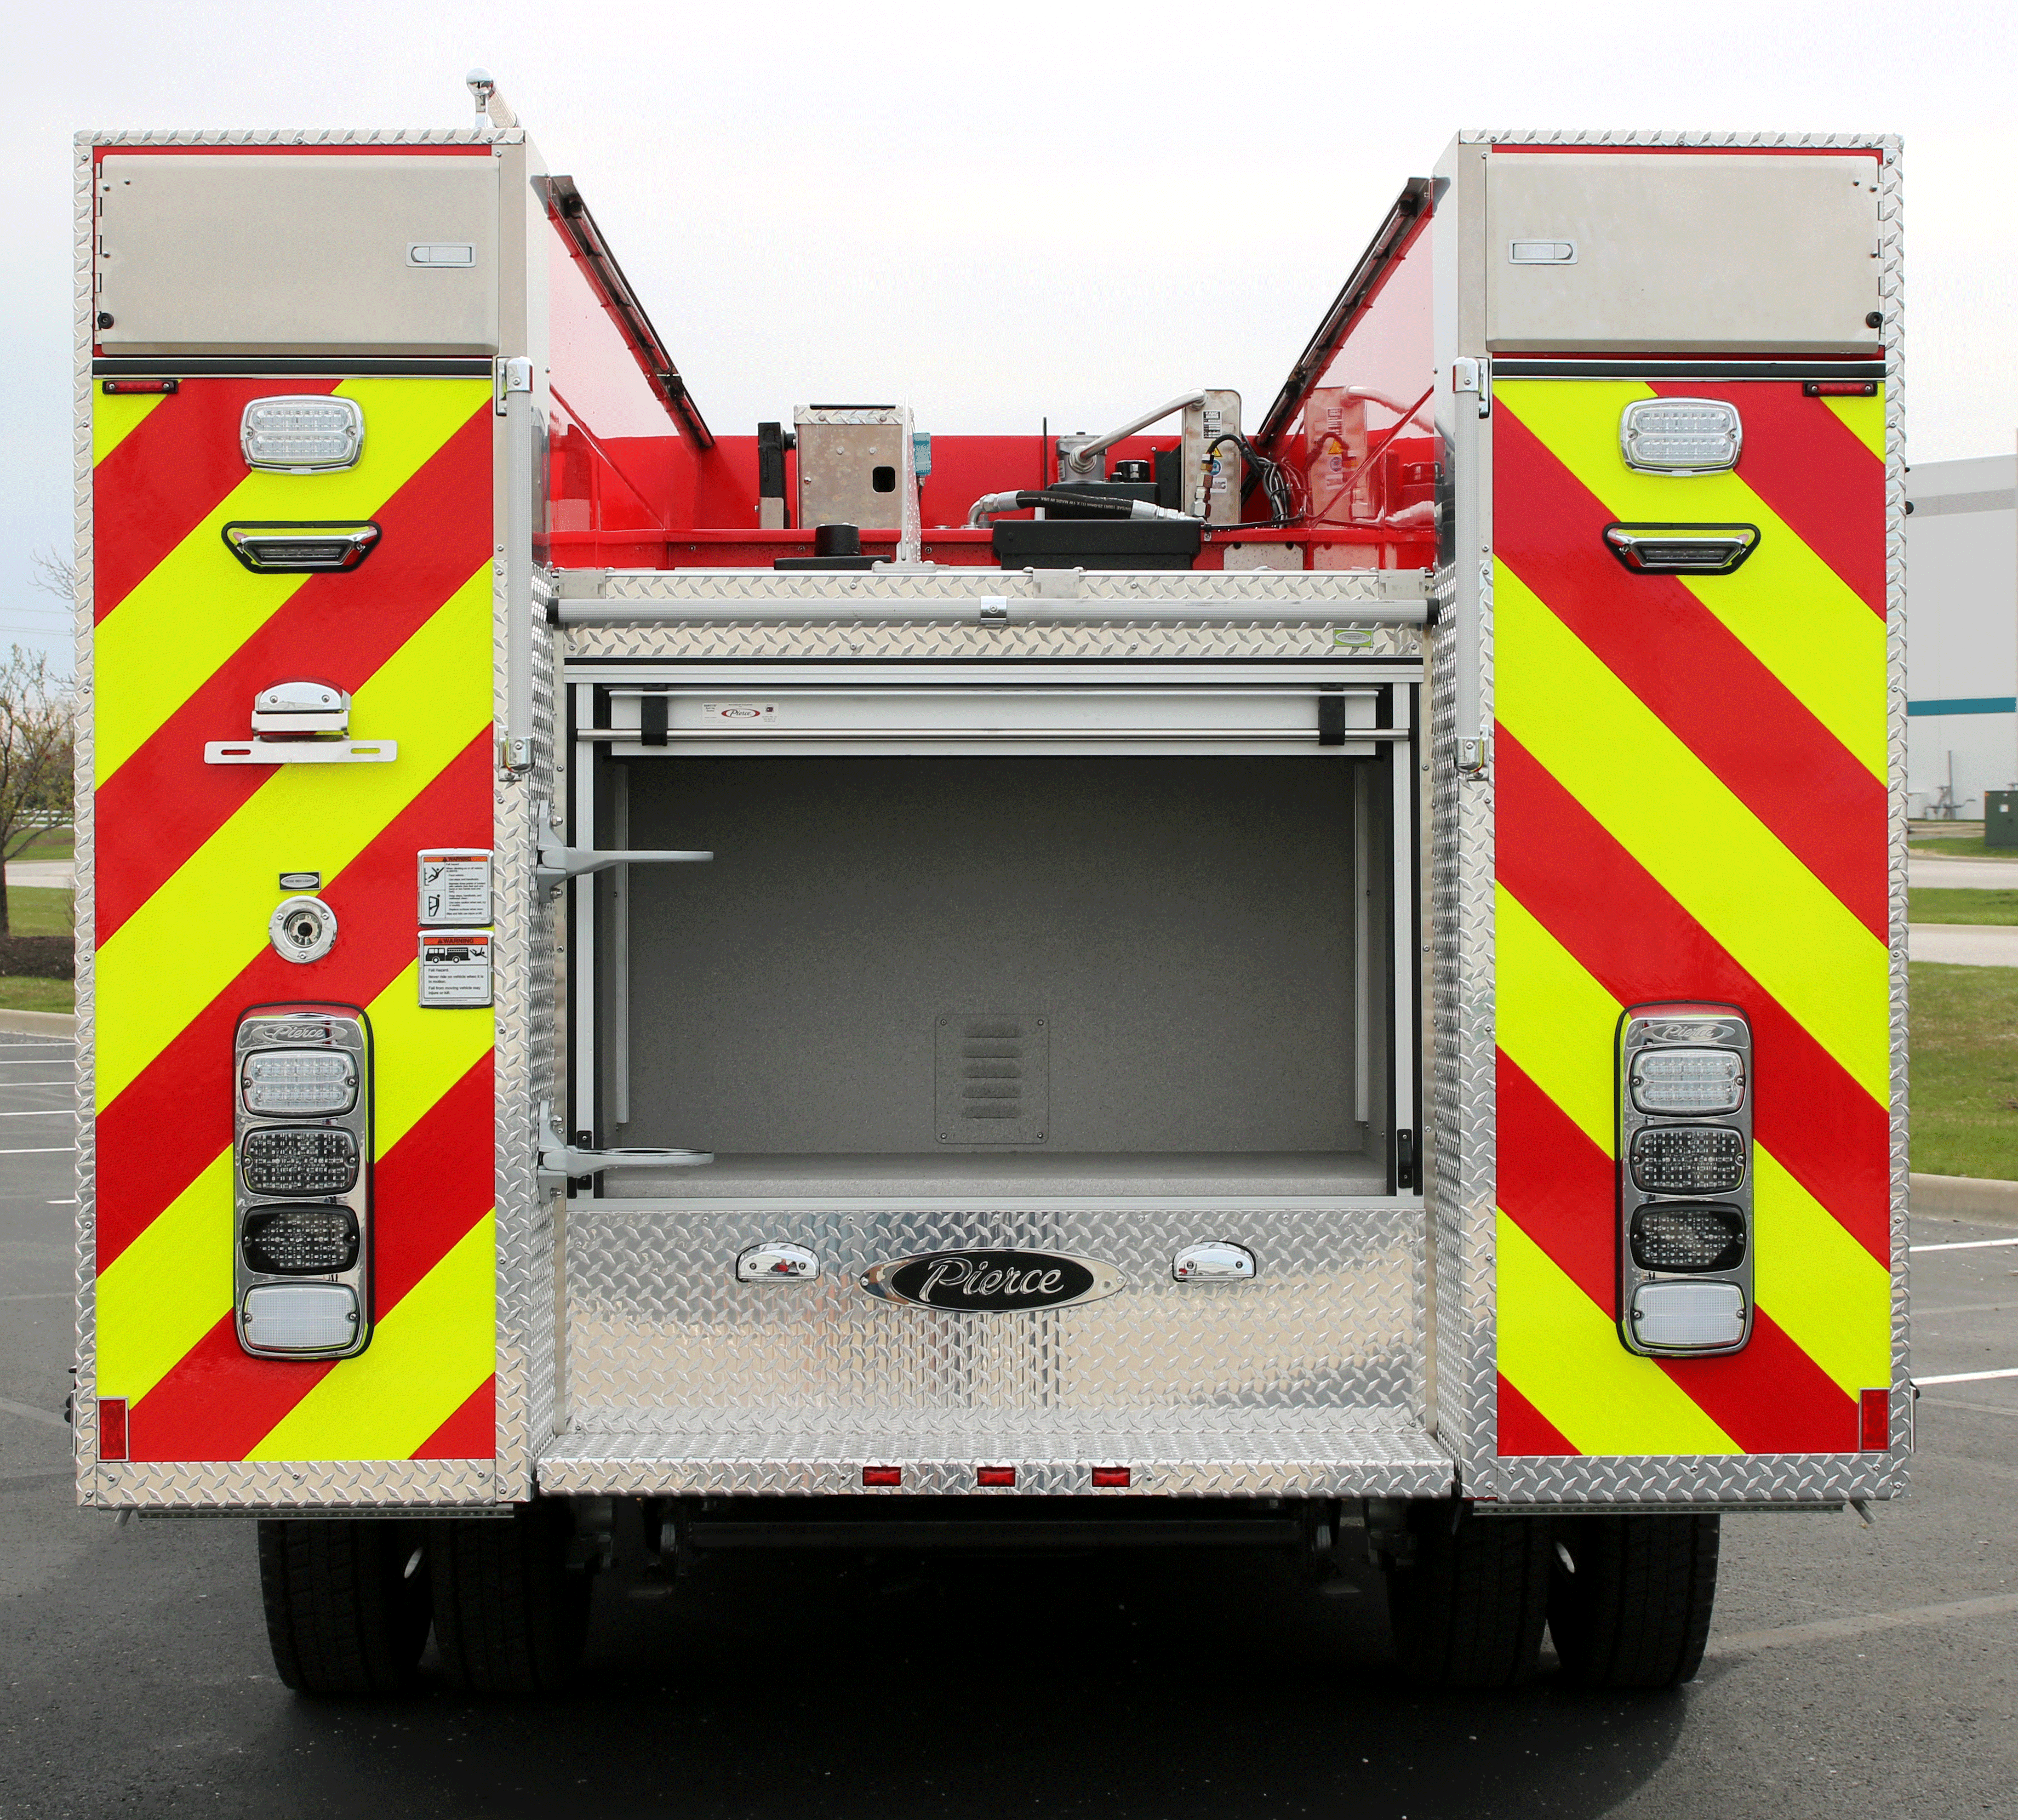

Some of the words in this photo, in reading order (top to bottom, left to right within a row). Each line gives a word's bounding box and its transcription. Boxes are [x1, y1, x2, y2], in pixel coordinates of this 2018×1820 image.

[272, 1025, 325, 1040] Pierce
[1662, 1024, 1714, 1039] Pierce
[919, 1257, 1064, 1302] Pierce
